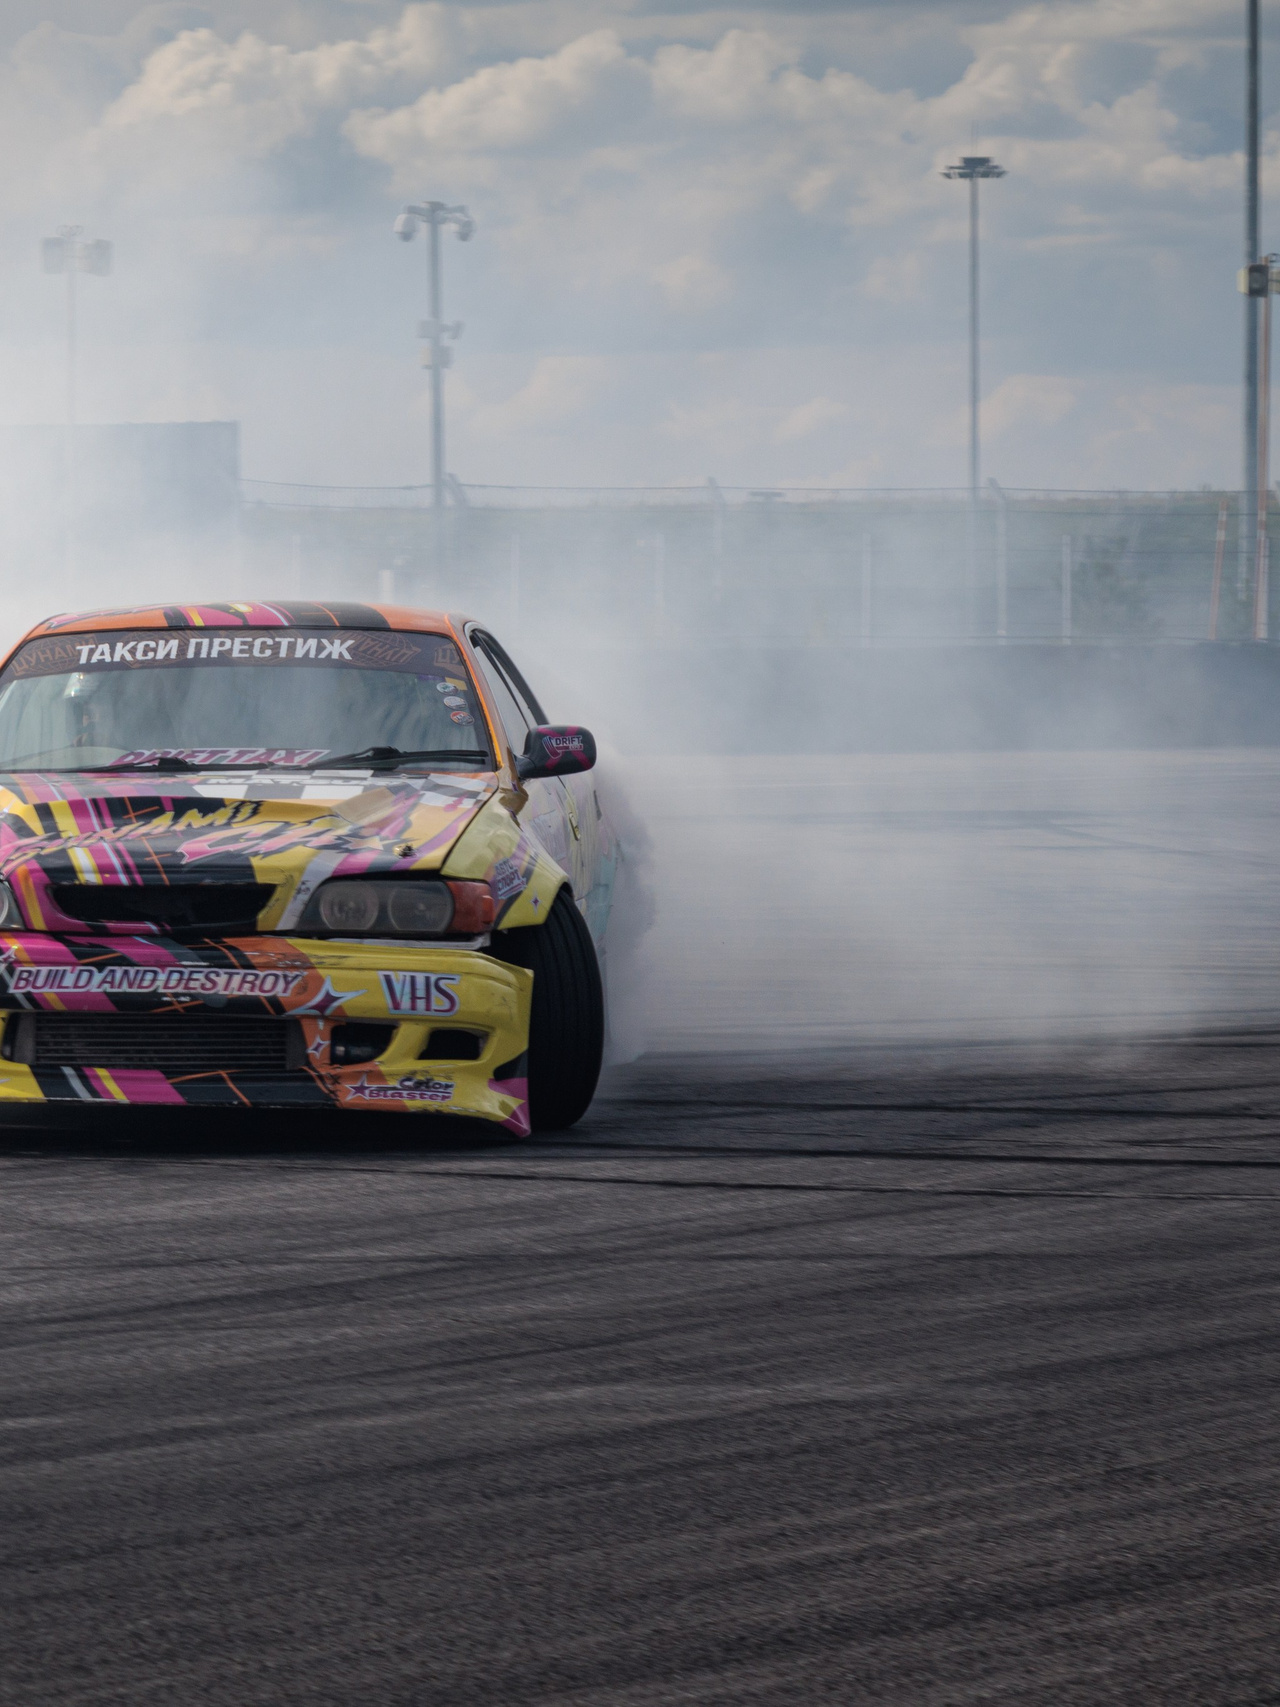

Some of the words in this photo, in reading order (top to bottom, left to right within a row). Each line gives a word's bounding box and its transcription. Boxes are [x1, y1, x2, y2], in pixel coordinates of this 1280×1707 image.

[76, 639, 178, 664] ТАКСИ
[187, 637, 355, 660] ПРЕСТИЖ
[555, 736, 582, 746] DRIFT
[13, 969, 94, 990] BUILD
[98, 970, 163, 991] AND
[163, 970, 301, 995] DESTROY
[381, 973, 457, 1013] VHS
[368, 1089, 452, 1102] Blaster
